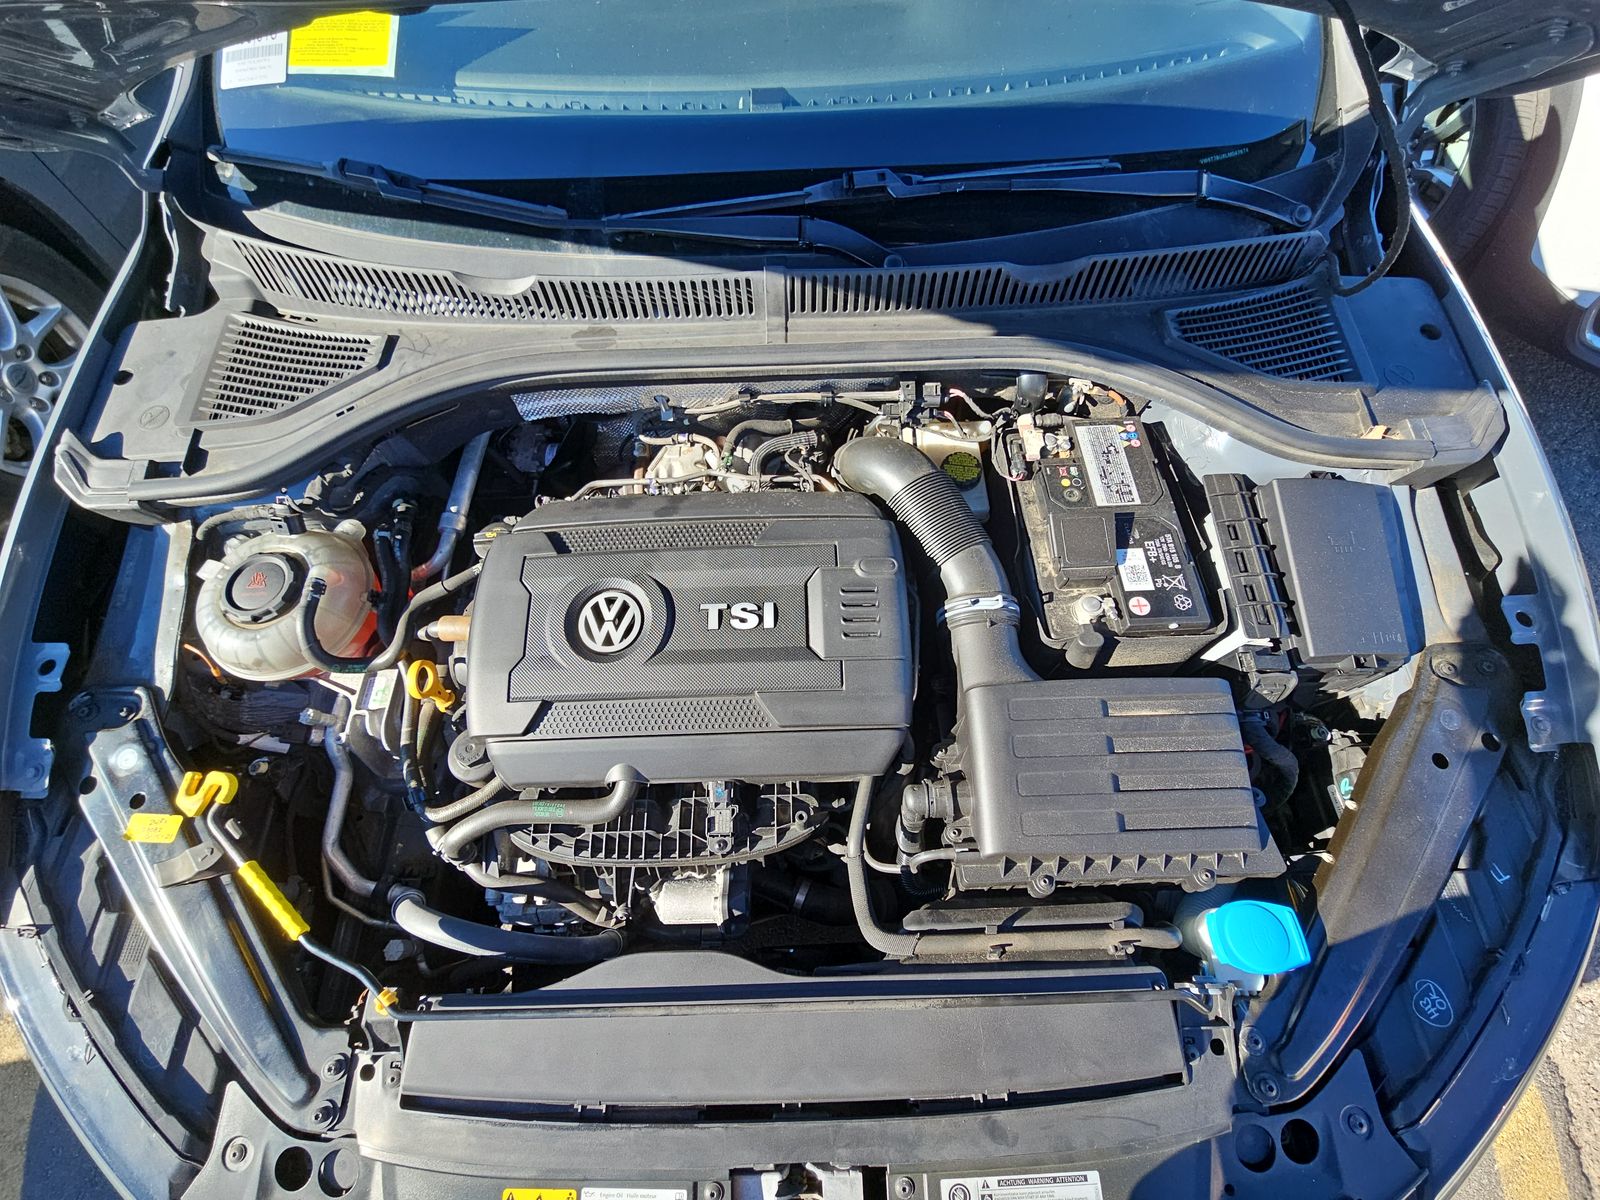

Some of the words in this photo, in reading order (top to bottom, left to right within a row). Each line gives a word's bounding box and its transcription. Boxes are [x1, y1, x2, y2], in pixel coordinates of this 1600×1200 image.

[1144, 540, 1158, 563] EFB+
[1154, 578, 1162, 588] Pb
[699, 601, 776, 630] TSI
[999, 1178, 1026, 1187] ACHTUNG
[1027, 1177, 1054, 1185] WARNING
[1056, 1175, 1085, 1183] ATTENTION
